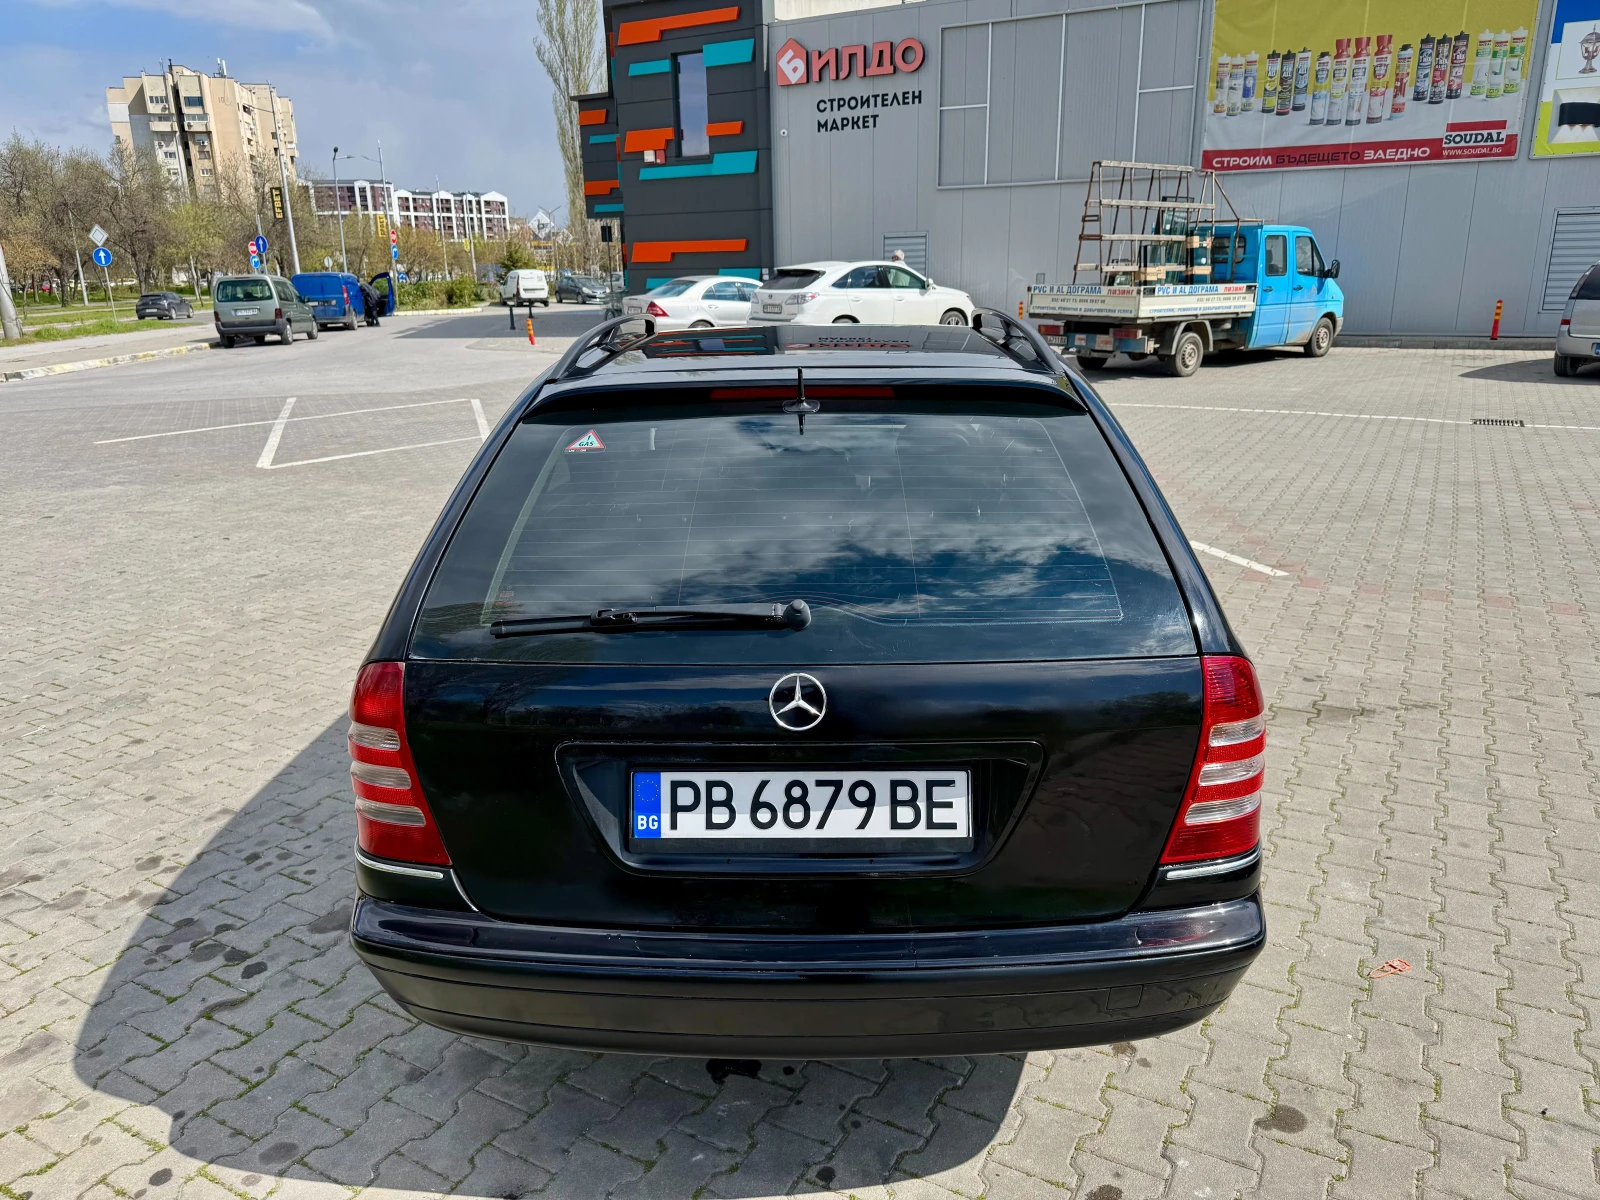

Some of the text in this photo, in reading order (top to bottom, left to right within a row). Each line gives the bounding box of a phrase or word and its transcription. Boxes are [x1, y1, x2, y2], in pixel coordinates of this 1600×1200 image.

[776, 38, 924, 86] БИЛДО
[816, 90, 922, 113] СТРОИТЕЛЕН
[817, 114, 879, 133] МАРКЕТ
[1444, 131, 1505, 145] SOUDAL
[1212, 147, 1430, 168] СТРОИМ БЪДЕЩЕТО ЗАЕДНО
[1442, 146, 1502, 158] WWW.SOUDAL.BG
[272, 189, 283, 218] EFBET
[1066, 286, 1102, 295] ДОГРАМА
[1188, 286, 1218, 295] ДОГРАМА
[669, 780, 958, 830] PB 6879 BE
[637, 815, 658, 830] BG
